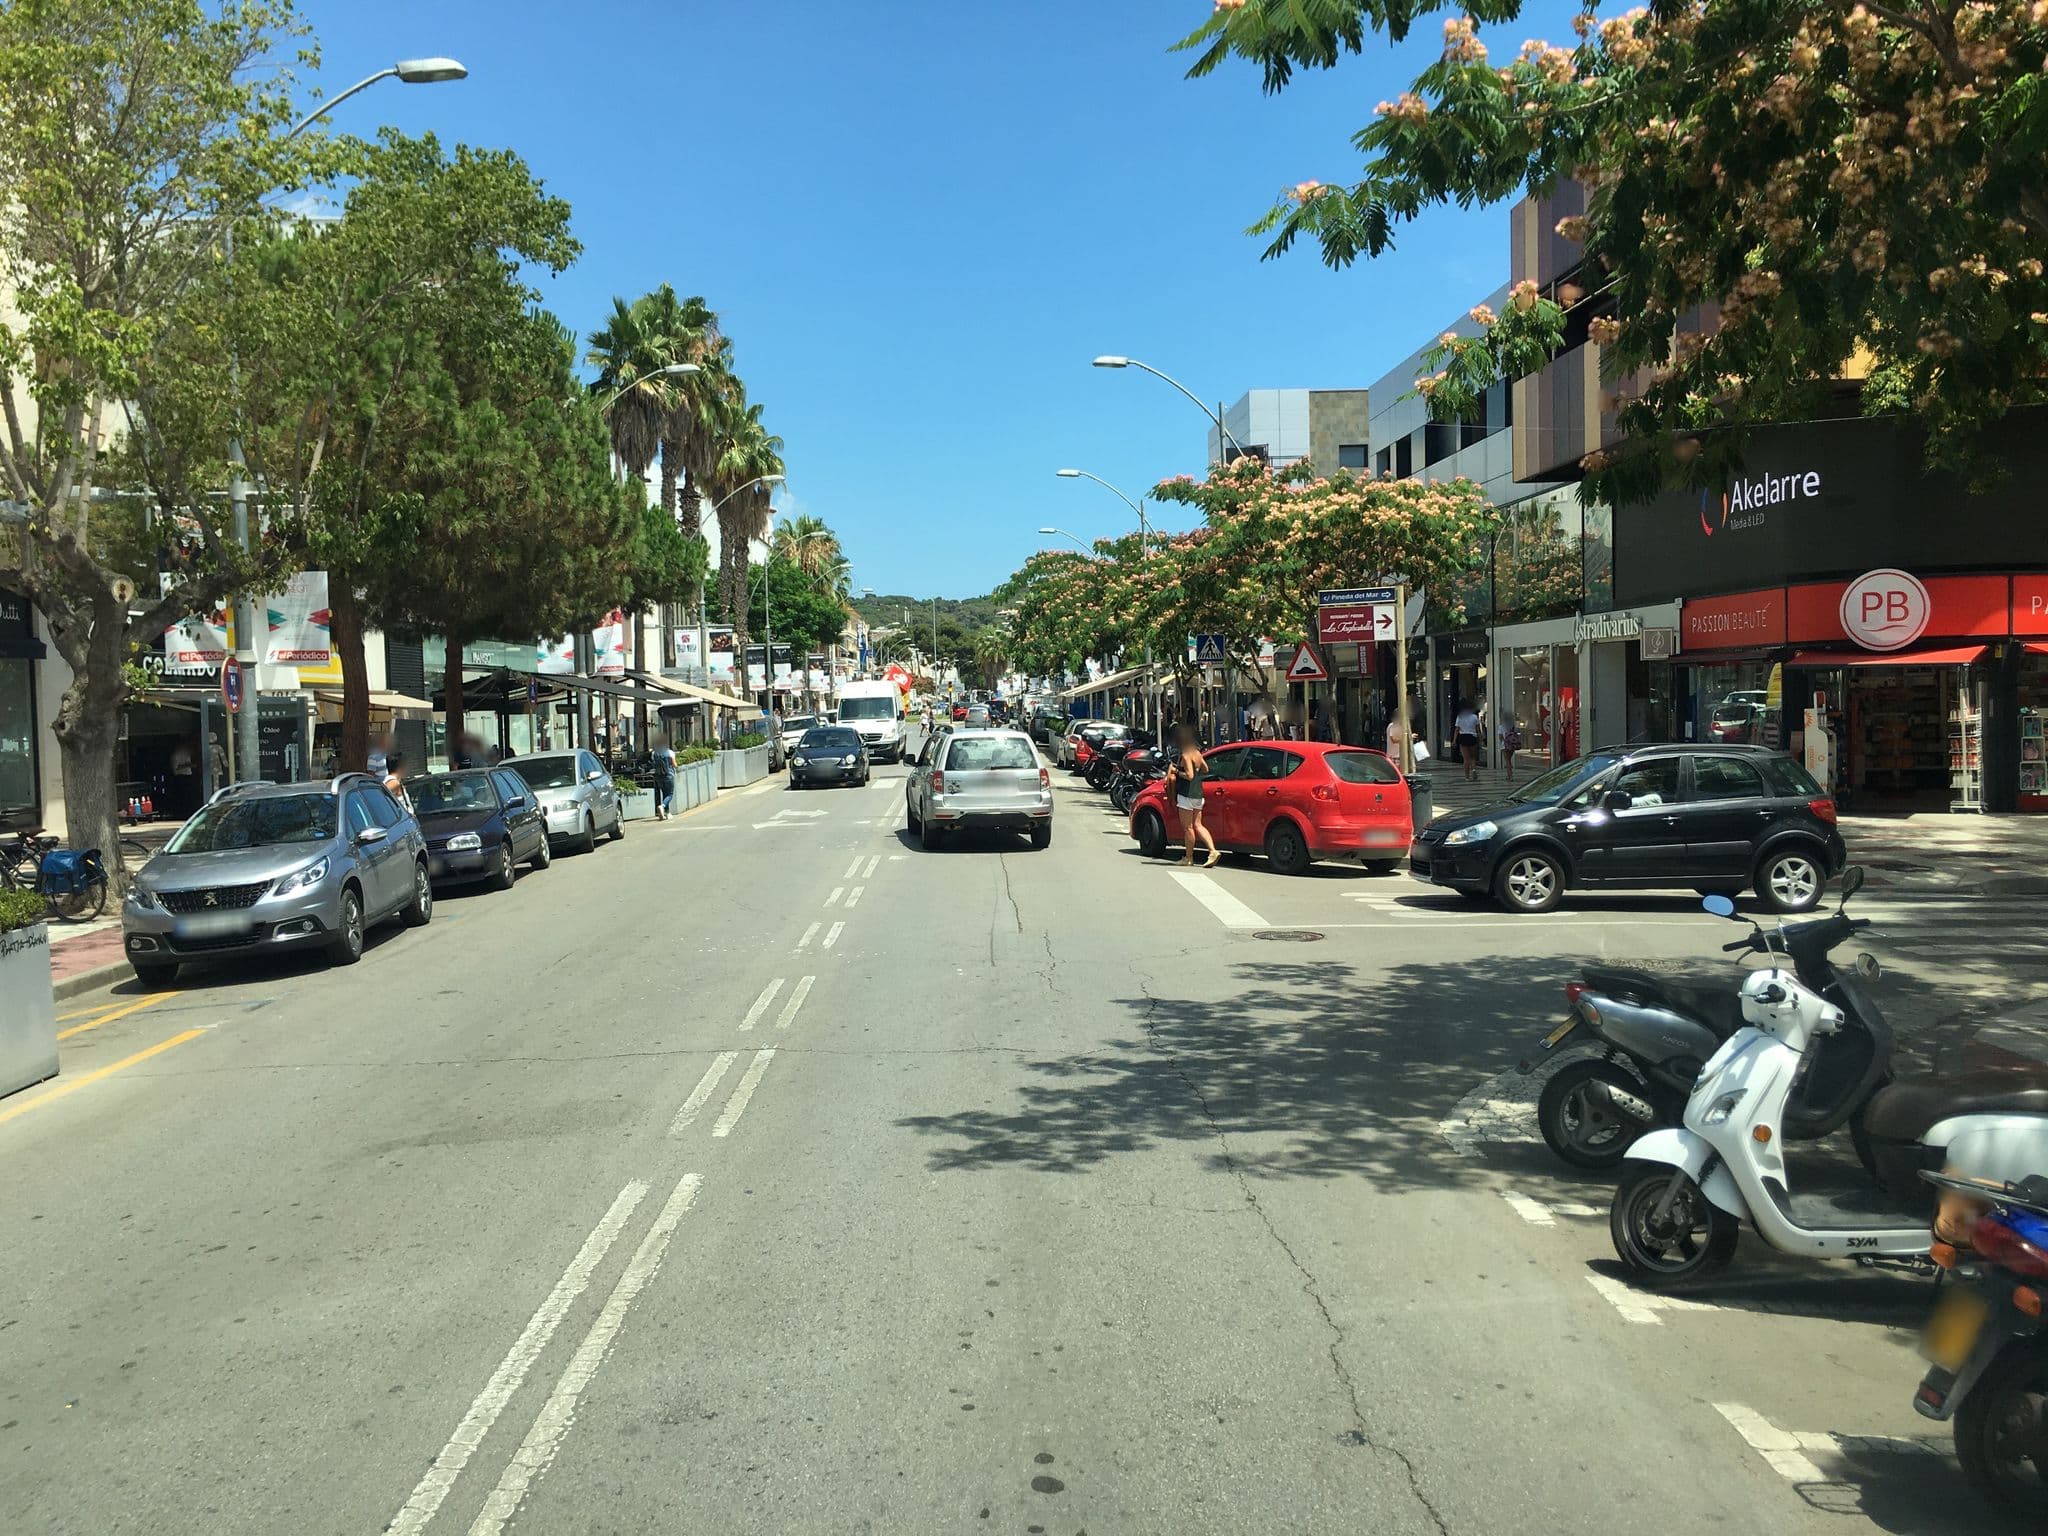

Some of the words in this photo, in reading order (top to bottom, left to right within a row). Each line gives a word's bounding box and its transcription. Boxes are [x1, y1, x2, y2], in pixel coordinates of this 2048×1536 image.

[1730, 471, 1820, 514] Akelarre
[1691, 613, 1730, 633] PASSION
[1732, 602, 1772, 630] BEAUTÉ
[1861, 591, 1910, 623] PB
[286, 651, 328, 660] Periódico
[1846, 1237, 1878, 1247] SYM
